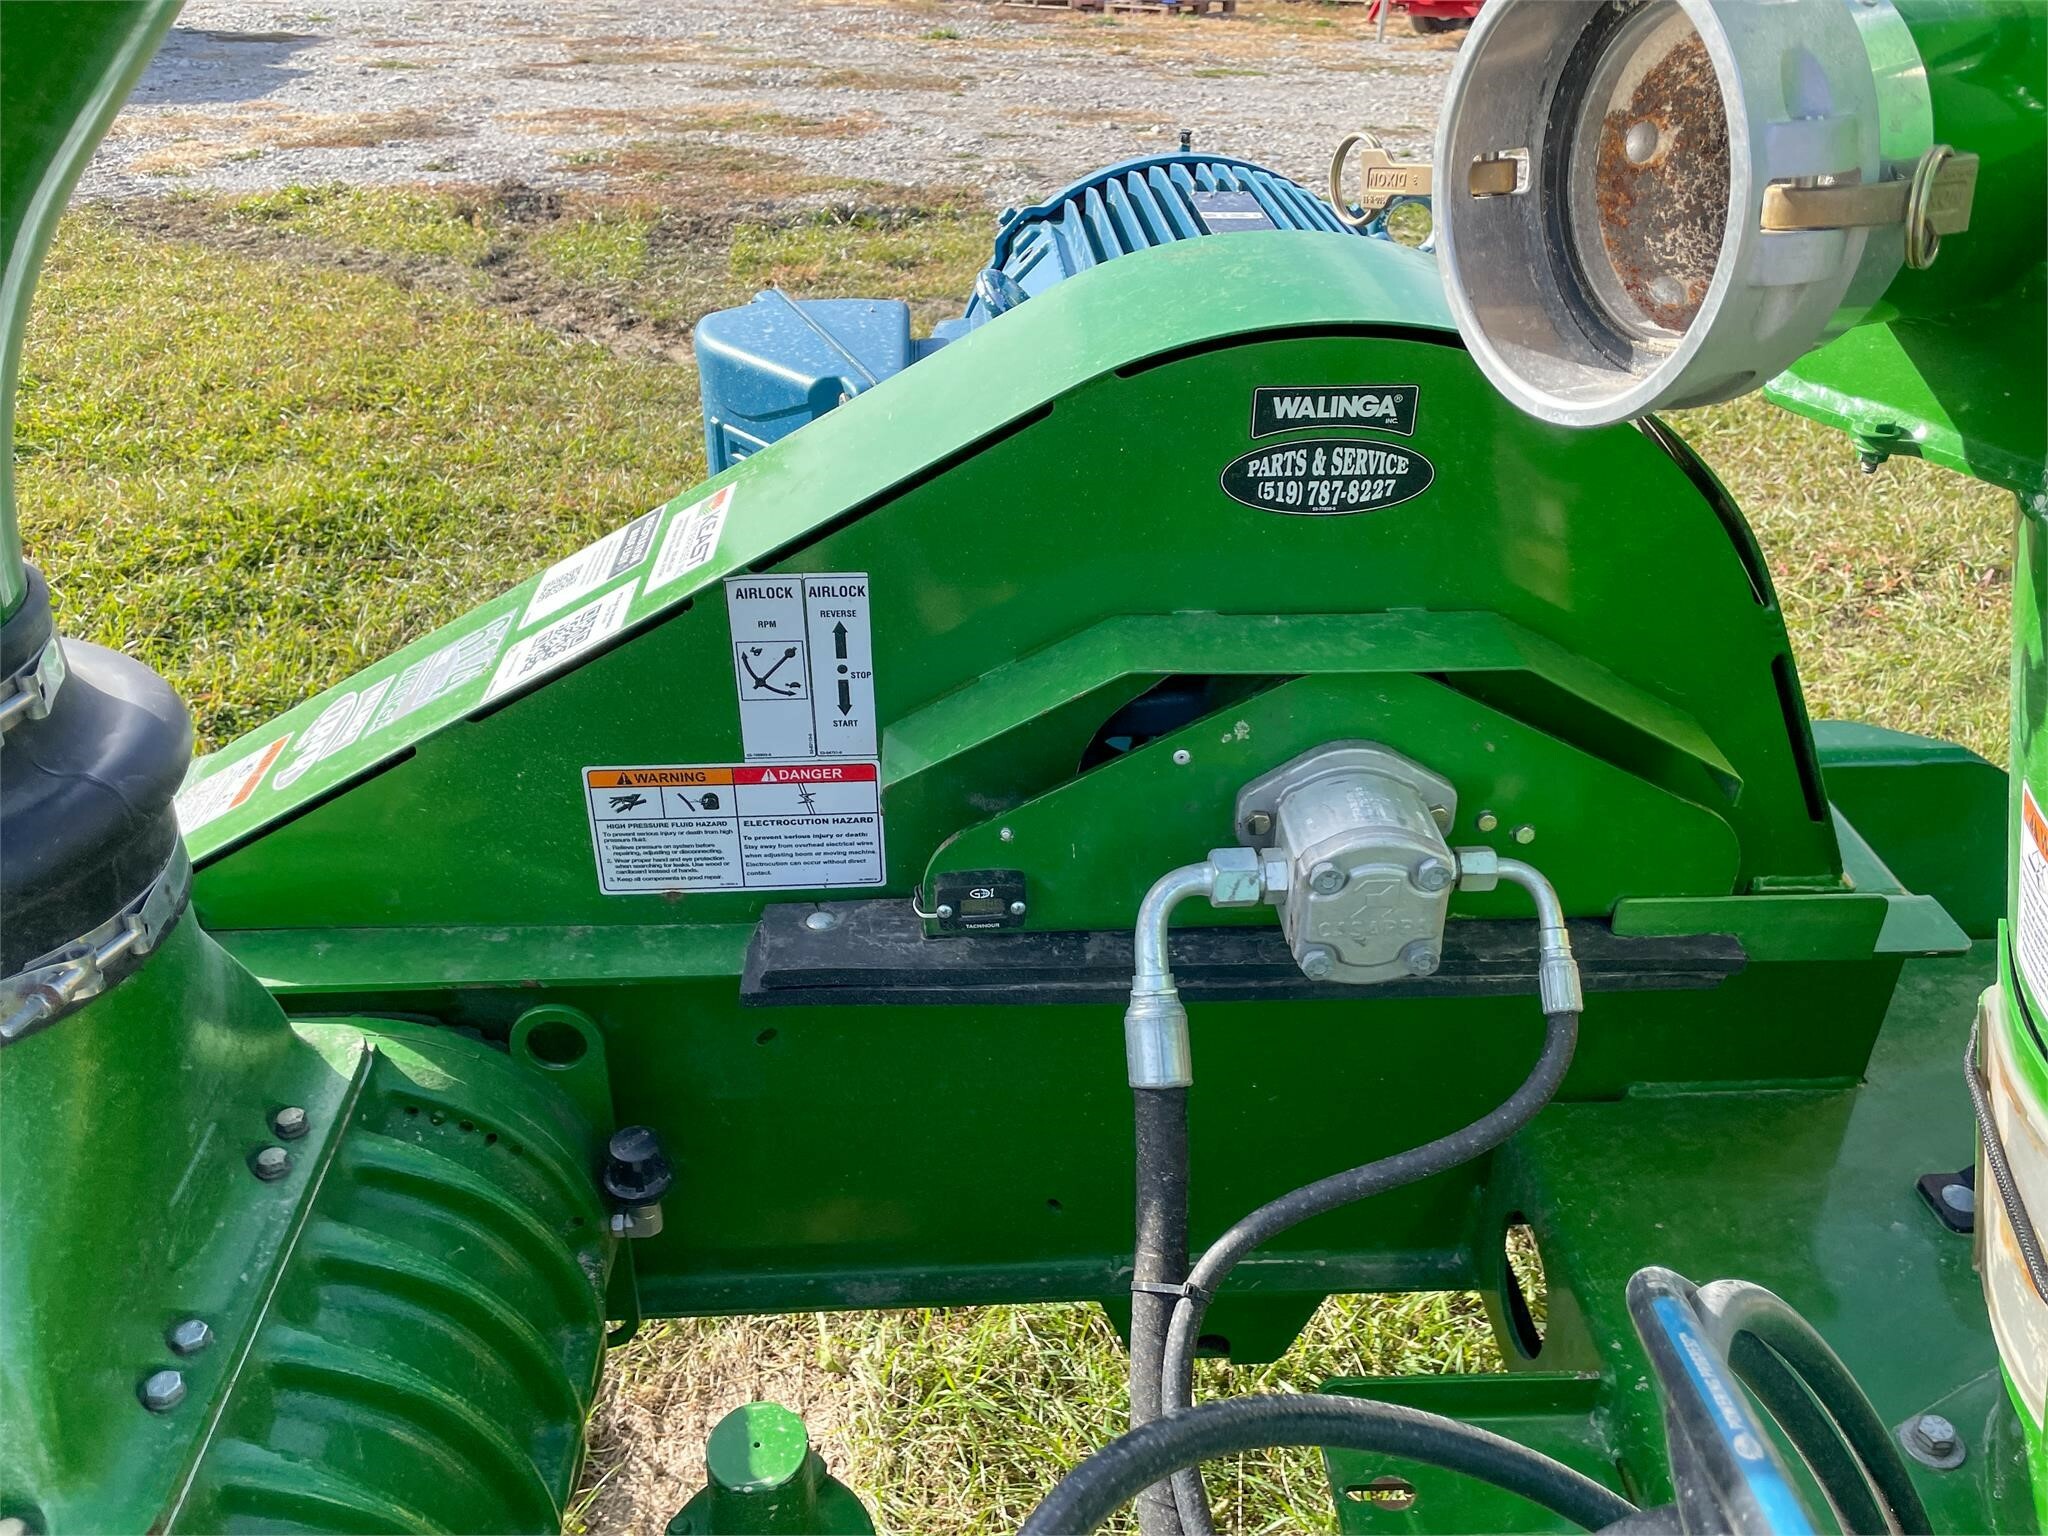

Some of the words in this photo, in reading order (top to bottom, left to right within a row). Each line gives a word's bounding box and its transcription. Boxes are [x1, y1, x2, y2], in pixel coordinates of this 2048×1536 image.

[1370, 171, 1407, 188] DIXON
[1273, 395, 1397, 419] WALINGA
[1247, 449, 1307, 478] PARTS
[1312, 447, 1327, 476] &
[1330, 447, 1409, 476] SERVICE
[1258, 481, 1304, 506] (519)
[1307, 480, 1396, 506] 787-8227
[736, 587, 793, 599] AIRLOCK
[809, 585, 866, 597] AIRLOCK
[820, 610, 857, 618] REVERSE
[757, 620, 777, 628] RPM
[851, 671, 872, 679] STOP
[833, 719, 858, 727] START
[634, 772, 706, 784] WARNING
[779, 768, 842, 781] DANGER
[743, 818, 829, 827] ELECTROCUTION
[832, 816, 873, 824] HAZARD
